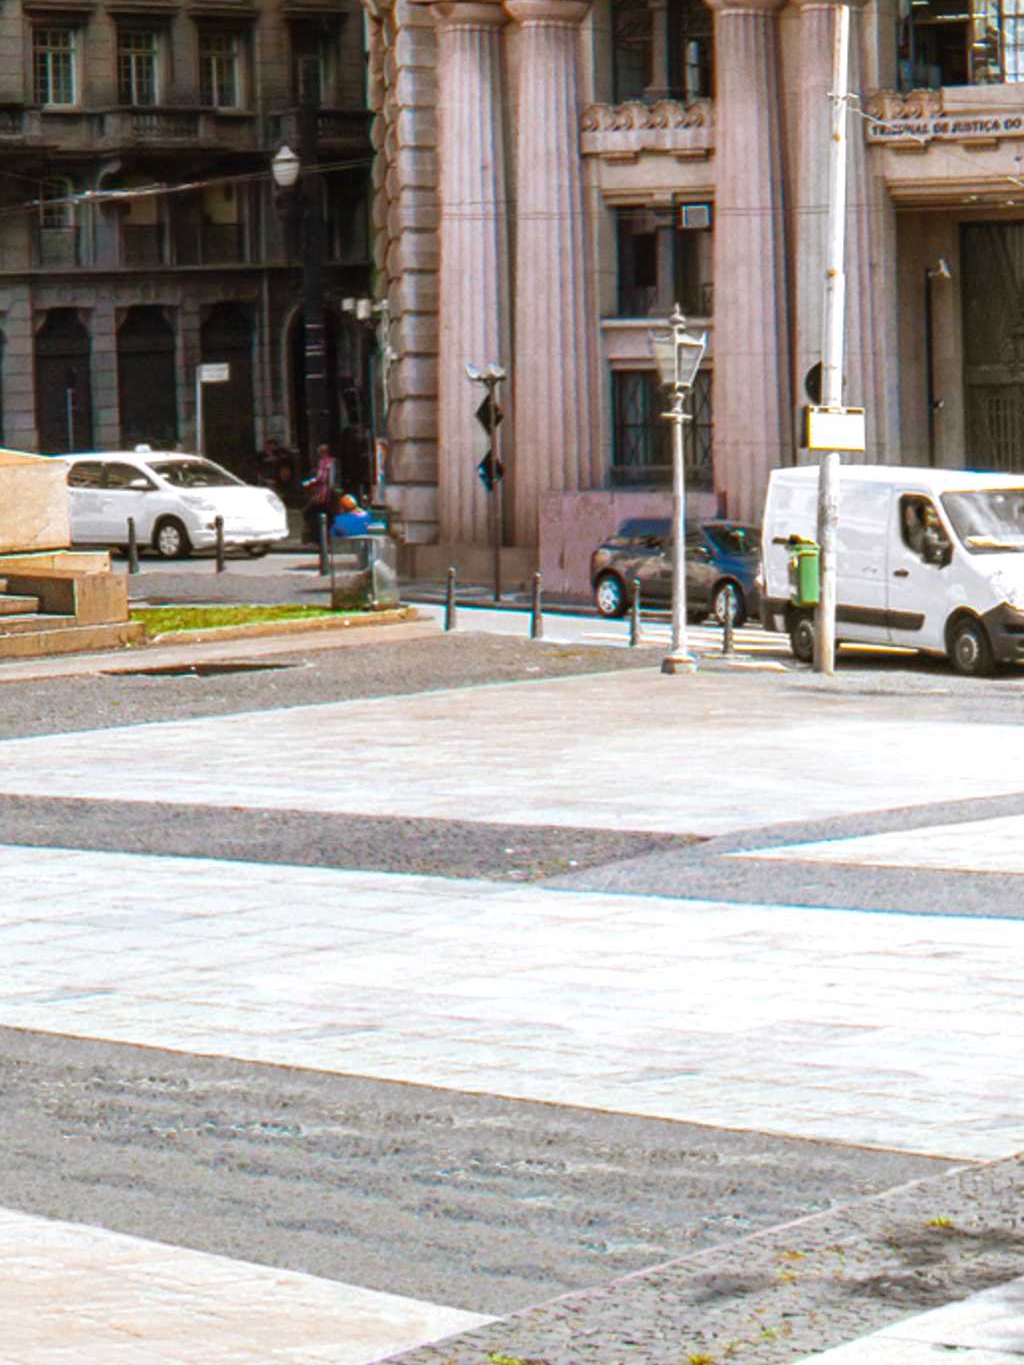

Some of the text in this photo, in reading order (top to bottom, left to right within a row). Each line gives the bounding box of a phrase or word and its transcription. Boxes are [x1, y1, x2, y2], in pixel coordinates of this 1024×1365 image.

[933, 121, 949, 134] DE
[952, 119, 1001, 133] JUSTIÇA
[1004, 117, 1022, 130] DO
